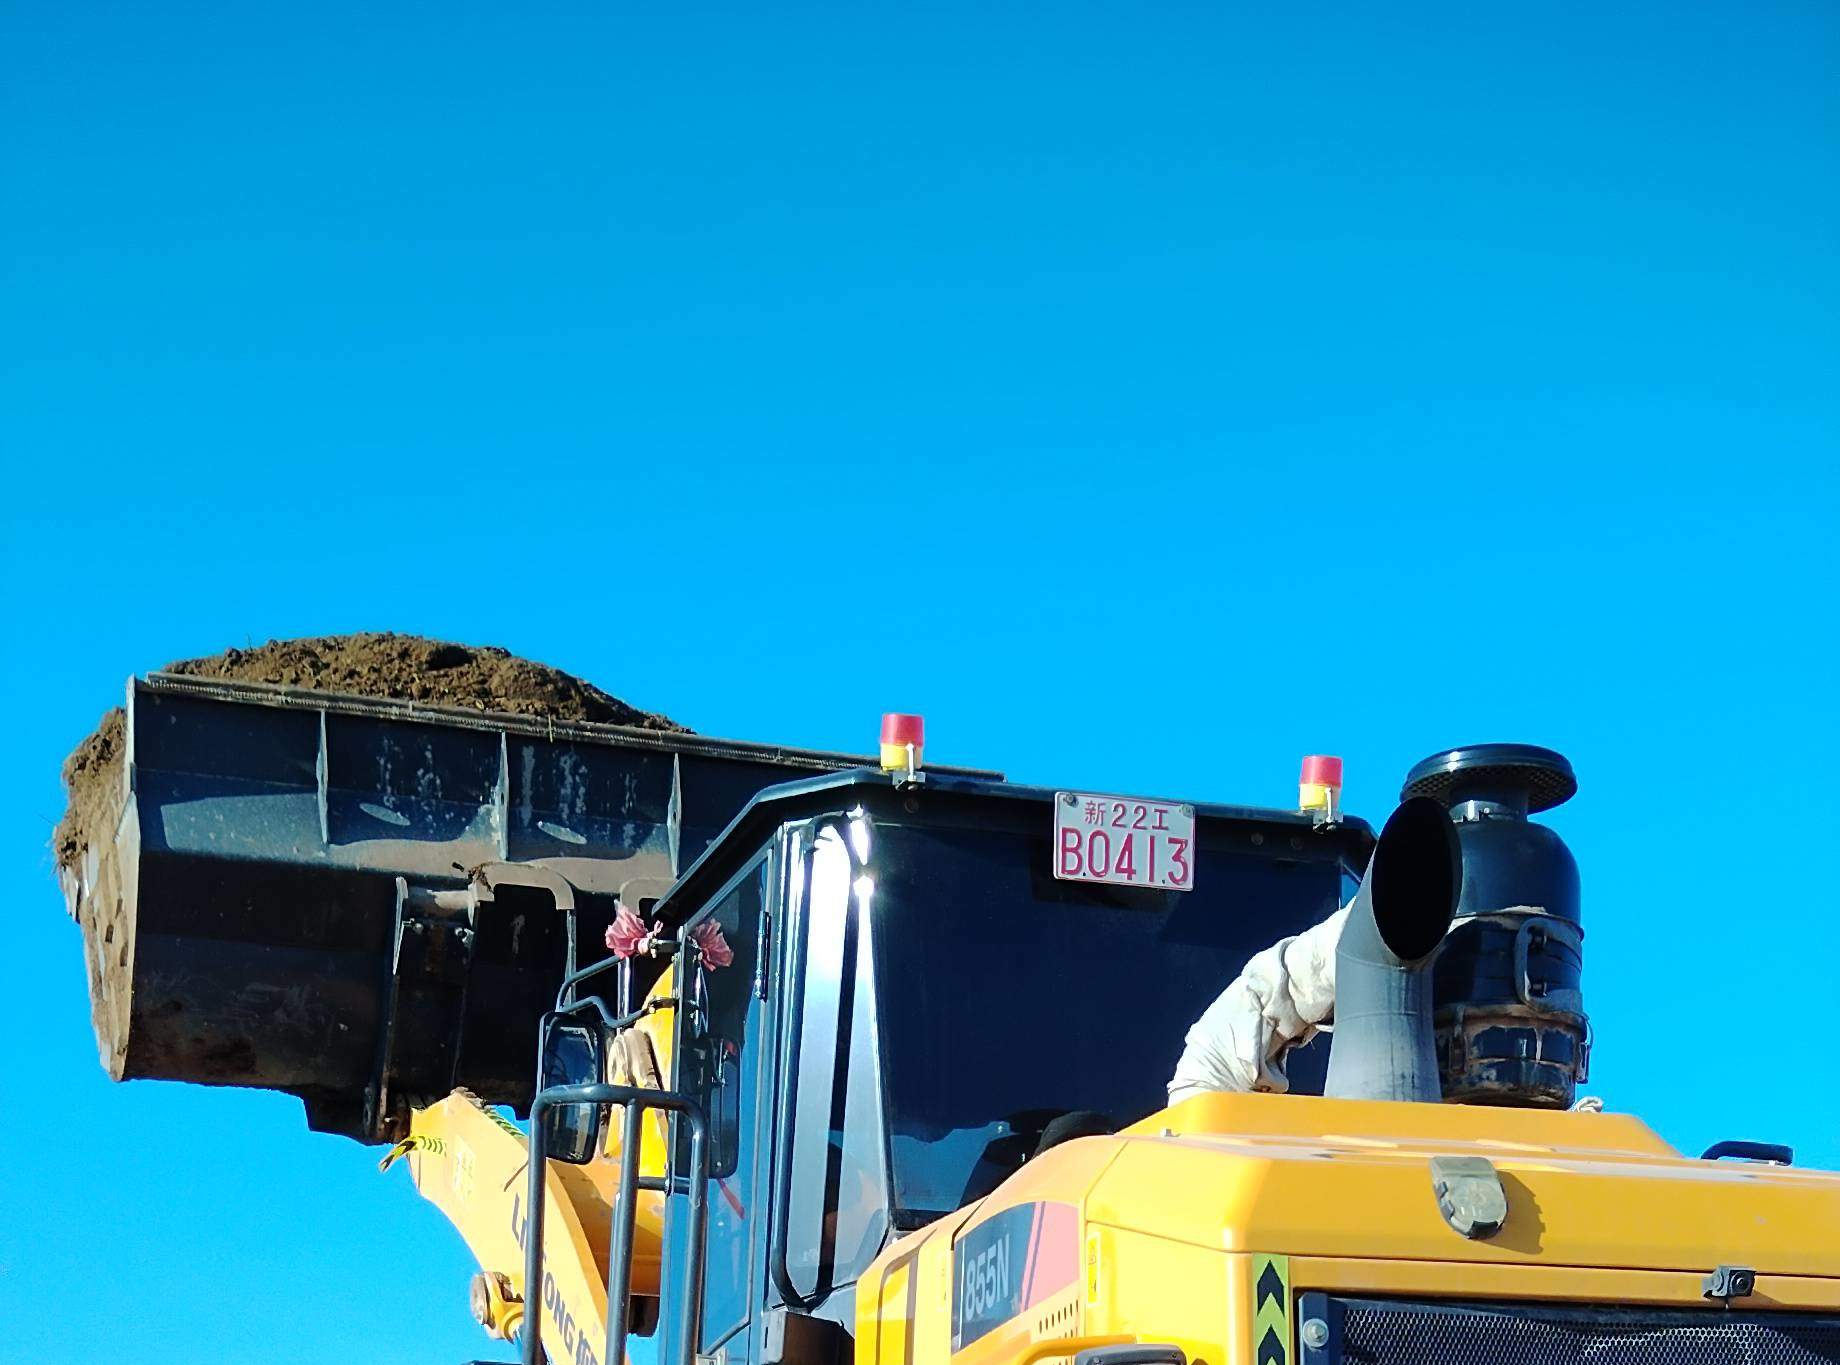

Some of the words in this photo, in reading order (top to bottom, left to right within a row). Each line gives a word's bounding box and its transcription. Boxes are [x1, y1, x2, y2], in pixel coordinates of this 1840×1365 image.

[1085, 800, 1169, 831] 新22工
[1061, 826, 1189, 885] B0413
[512, 1191, 576, 1355] LIONG
[964, 1232, 1010, 1322] 855N
